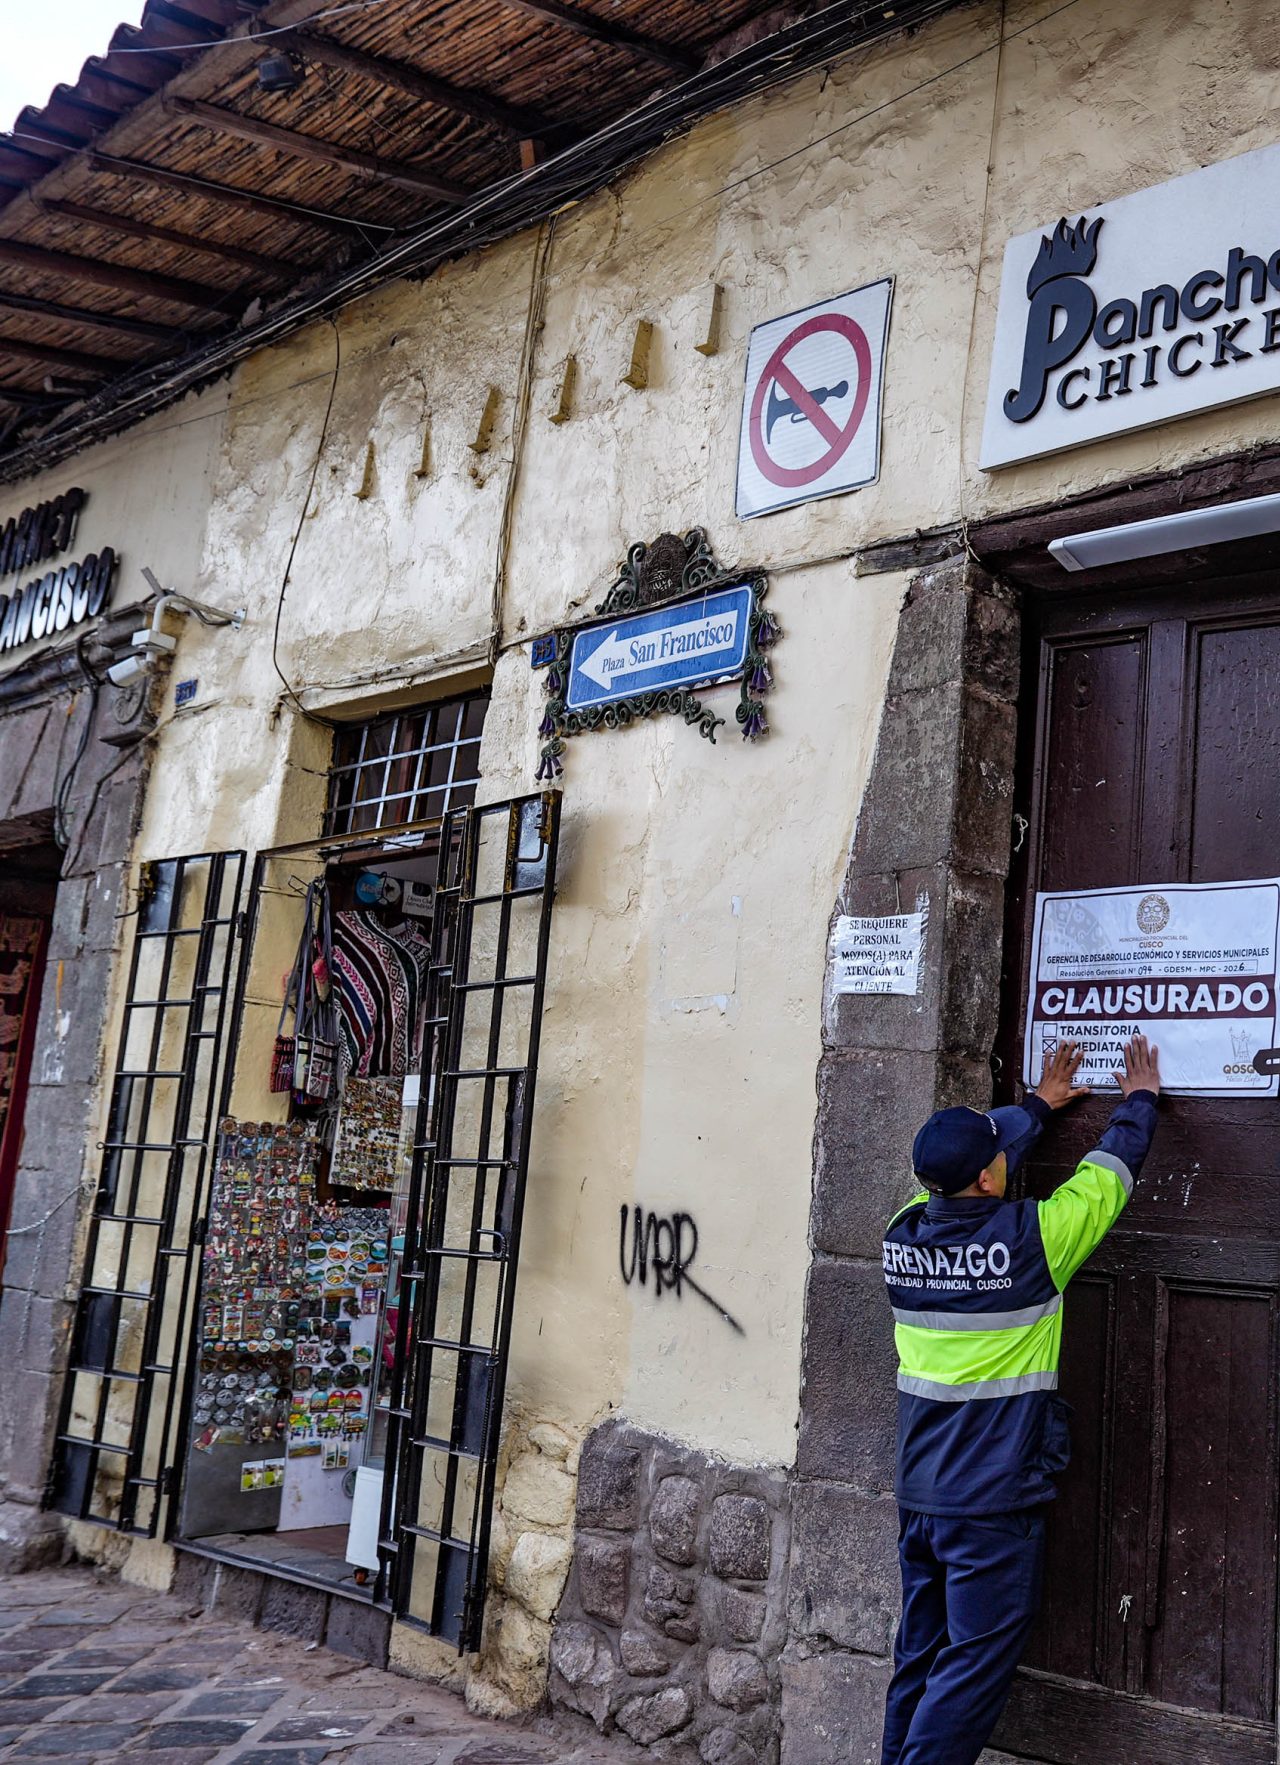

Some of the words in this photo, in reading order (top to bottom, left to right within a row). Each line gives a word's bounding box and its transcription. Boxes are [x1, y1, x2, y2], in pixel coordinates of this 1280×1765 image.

[601, 657, 625, 674] Plaza
[629, 640, 656, 666] San
[659, 621, 733, 659] Francisco
[849, 919, 859, 930] SE
[861, 918, 908, 931] REQUIERE
[853, 934, 901, 945] PERSONAL
[1139, 941, 1164, 949] CUSCO
[841, 950, 886, 963] MOZOS(A)
[888, 949, 913, 961] PARA
[1046, 955, 1079, 964] GERENCIA
[1080, 954, 1089, 963] DE
[1090, 953, 1132, 962] DESARROLLO
[1133, 949, 1173, 960] ECONÓMICO
[1175, 950, 1181, 958] Y
[1182, 950, 1222, 959] SERVICIOS
[1223, 947, 1270, 957] MUNICIPALES
[844, 963, 891, 976] ATENCIÓN
[893, 966, 905, 976] AL
[1060, 969, 1095, 977] Resolución
[1096, 968, 1126, 976] Gerencial
[854, 981, 893, 992] CLIENTE
[1041, 982, 1270, 1015] CLAUSURADO
[1060, 1025, 1141, 1036] TRANSITORIA
[1064, 1042, 1125, 1052] MEDIATA
[1068, 1058, 1125, 1069] INITIVA
[1223, 1064, 1256, 1075] QOSQ
[883, 1241, 1011, 1278] ERENAZGO
[926, 1278, 972, 1291] PROVINCIAL
[976, 1277, 1012, 1291] CUSCO
